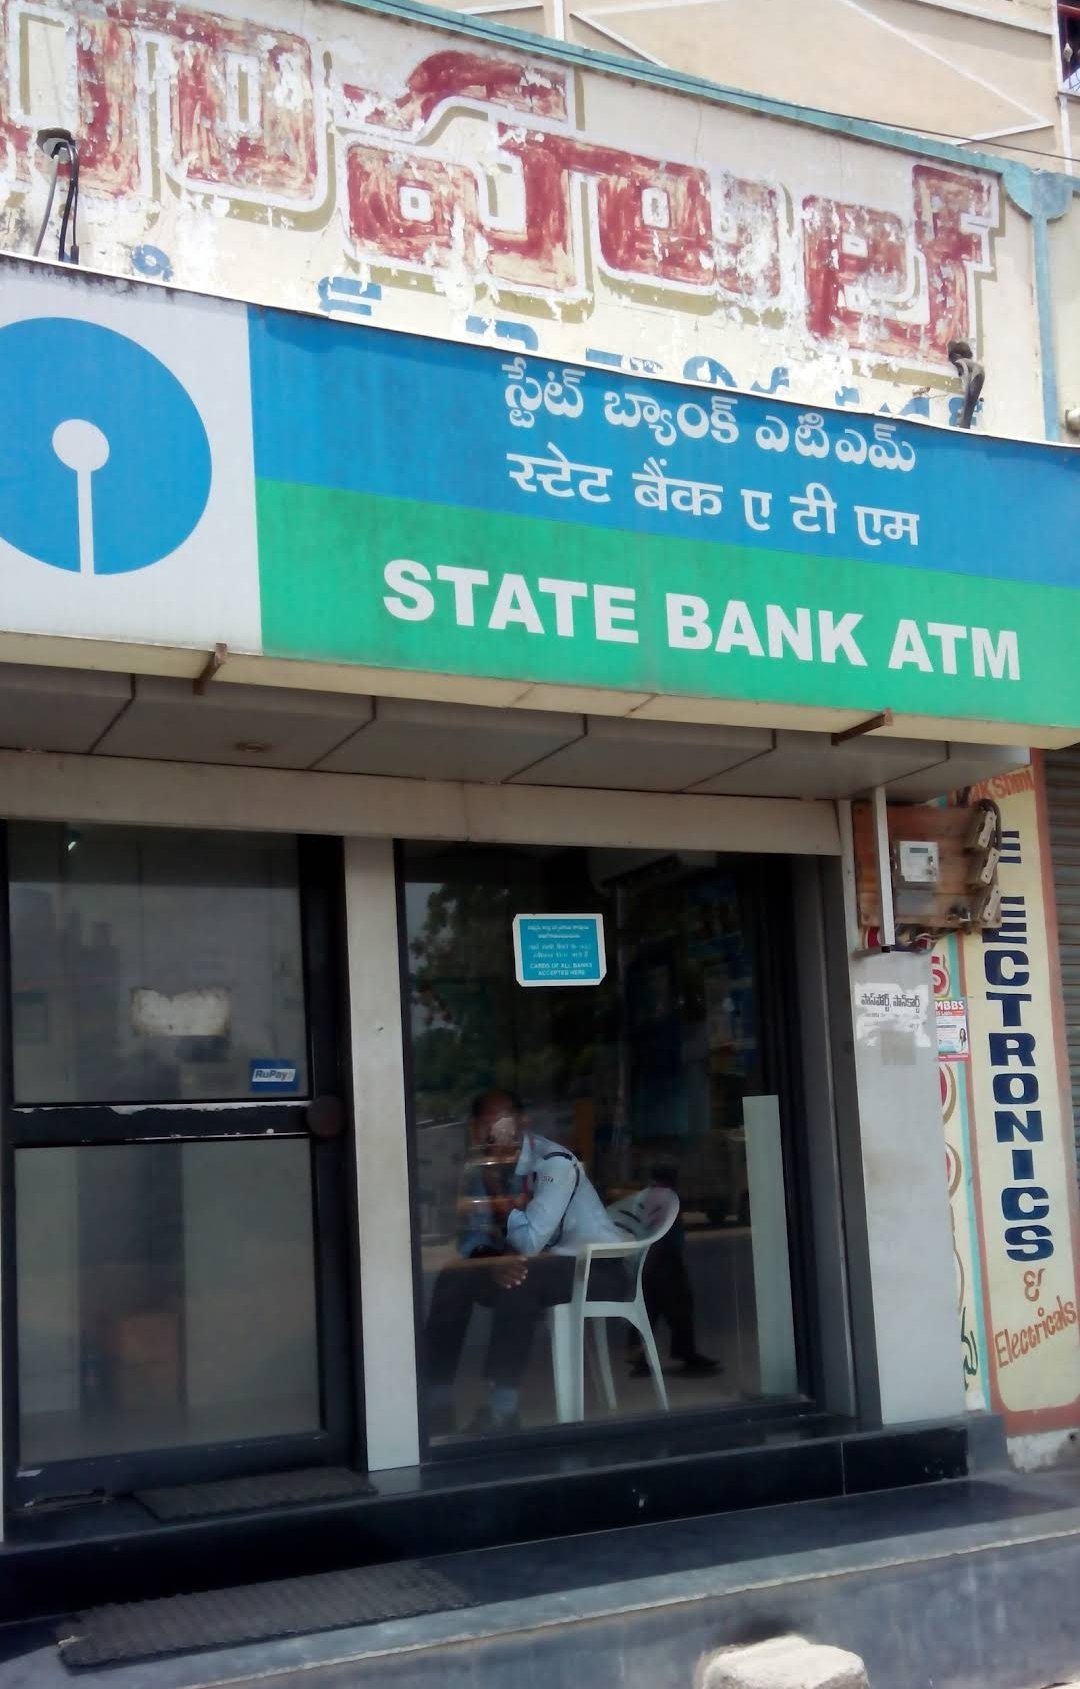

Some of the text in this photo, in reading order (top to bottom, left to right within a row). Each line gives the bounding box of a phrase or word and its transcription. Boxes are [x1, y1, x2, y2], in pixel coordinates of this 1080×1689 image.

[502, 356, 586, 430] స్టేట్
[603, 394, 740, 447] బ్యాంక్
[755, 412, 917, 472] ఎటిఎమ్
[506, 441, 920, 546] स्टेट बैंक ए टी एम
[383, 558, 1021, 682] STATE BANK ATM
[935, 1000, 964, 1011] MBBS
[981, 830, 1055, 1262] EECTRONICS
[255, 1070, 289, 1081] RuPay
[995, 1295, 1077, 1368] Electricals
